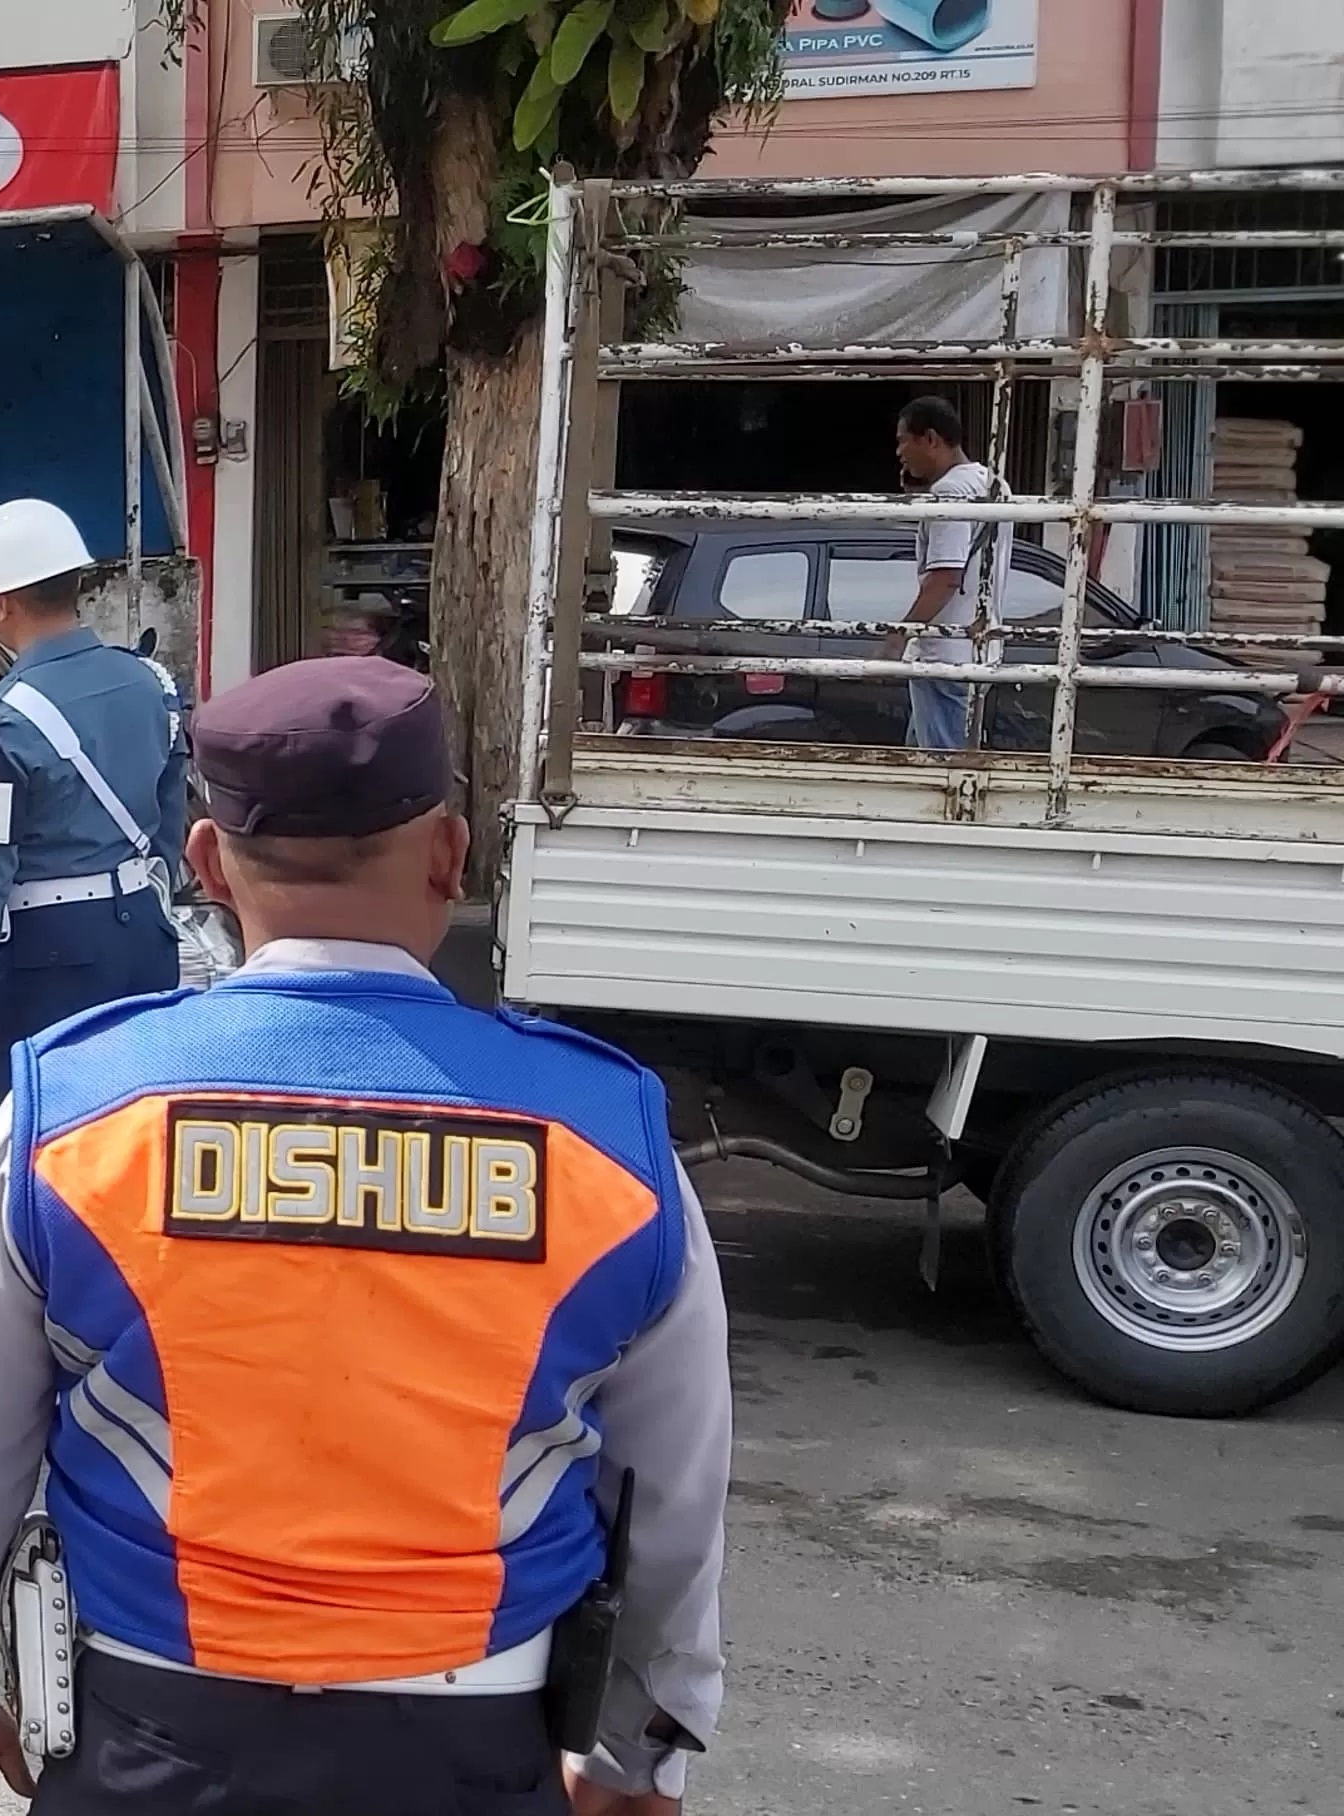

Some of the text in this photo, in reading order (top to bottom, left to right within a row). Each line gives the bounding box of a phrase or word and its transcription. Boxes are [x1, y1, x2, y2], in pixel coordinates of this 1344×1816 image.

[843, 33, 883, 48] PVC
[818, 73, 888, 87] SUDIRMAN
[891, 71, 937, 83] NO.209
[171, 1119, 537, 1241] DISHUB
